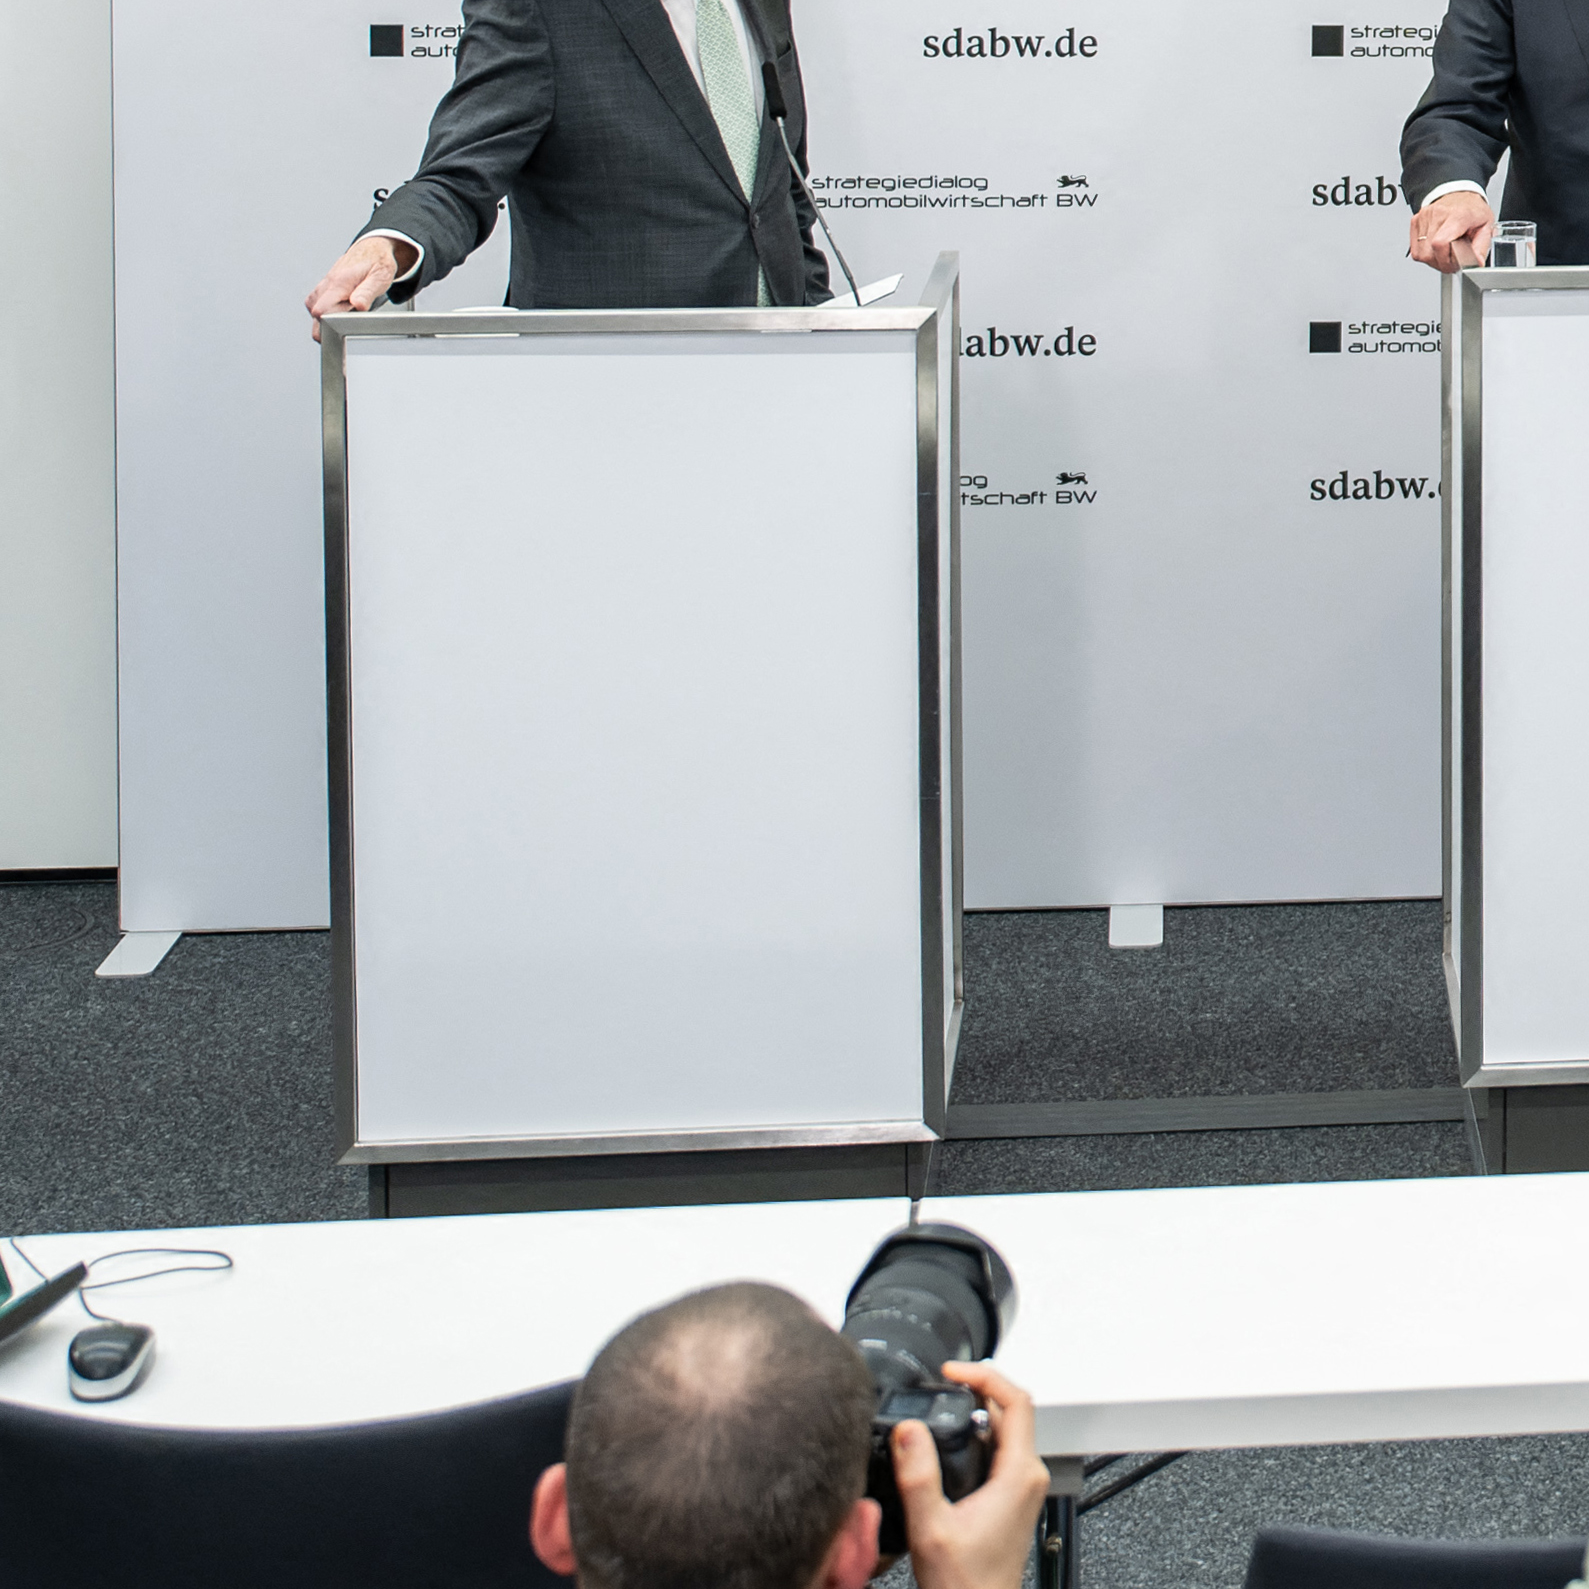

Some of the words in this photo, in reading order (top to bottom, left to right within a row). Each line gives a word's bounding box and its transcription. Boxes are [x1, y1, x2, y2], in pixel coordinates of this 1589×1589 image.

[1350, 24, 1438, 41] strategi
[923, 26, 1098, 58] sdabw.de
[811, 175, 989, 192] strategiedialog
[1312, 175, 1408, 207] sdab
[814, 194, 1048, 209] automobilwirtschaft
[1056, 193, 1099, 208] BW
[1348, 320, 1441, 337] strategi
[960, 326, 1097, 358] abw.de
[1310, 469, 1441, 501] sdabw.
[1055, 490, 1098, 505] BW
